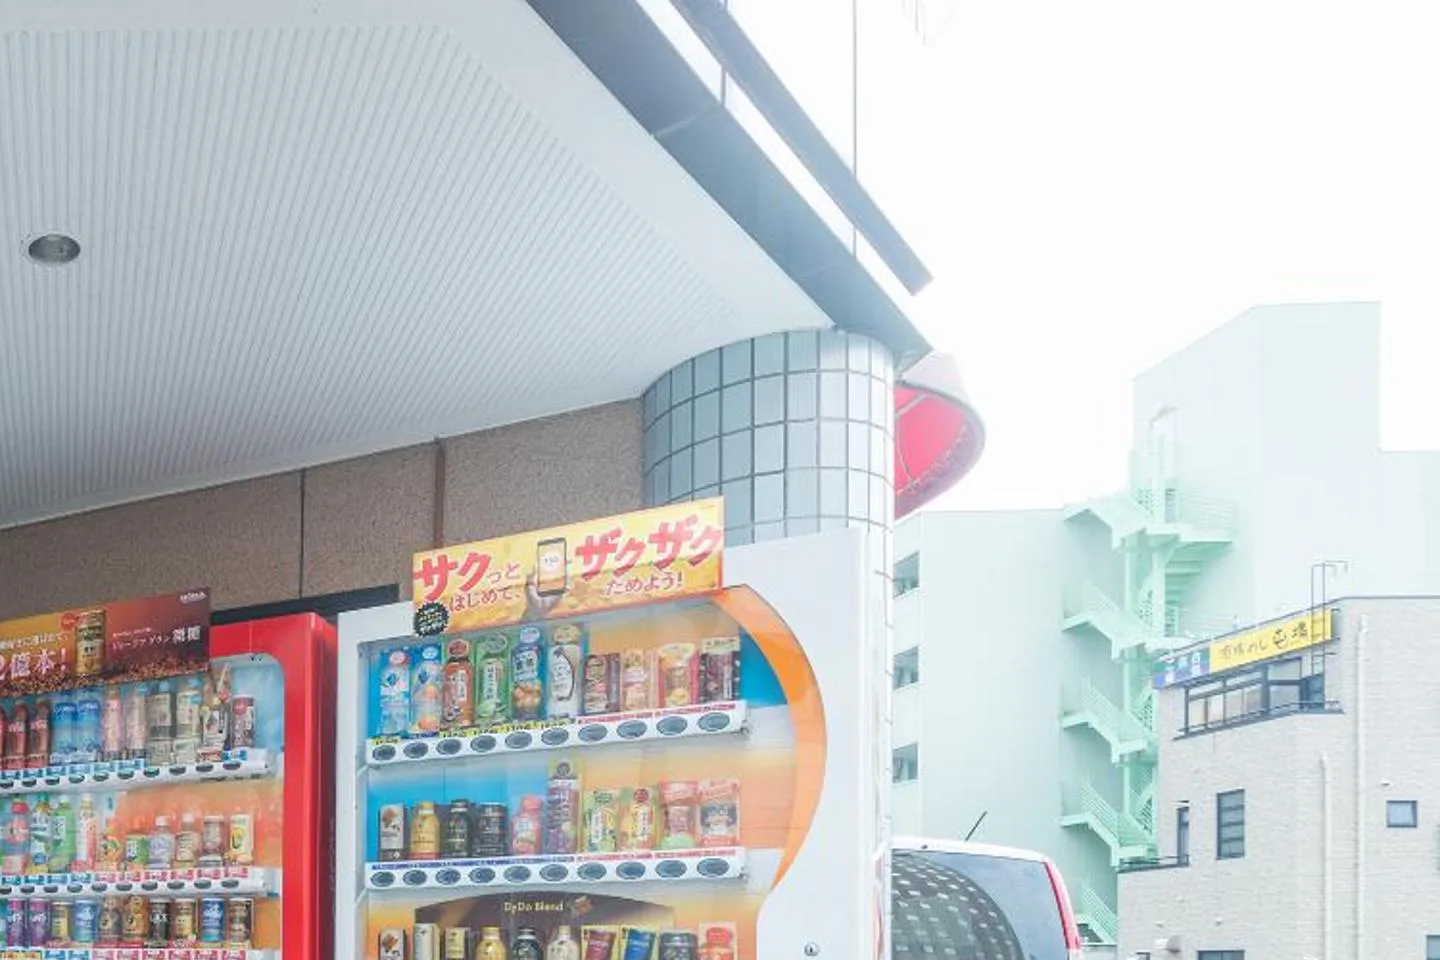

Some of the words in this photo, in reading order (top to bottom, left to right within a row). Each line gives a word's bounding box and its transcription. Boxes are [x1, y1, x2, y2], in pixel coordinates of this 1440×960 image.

[575, 514, 723, 582] ザクザク
[504, 901, 532, 914] DyDo
[534, 901, 564, 912] Blend
